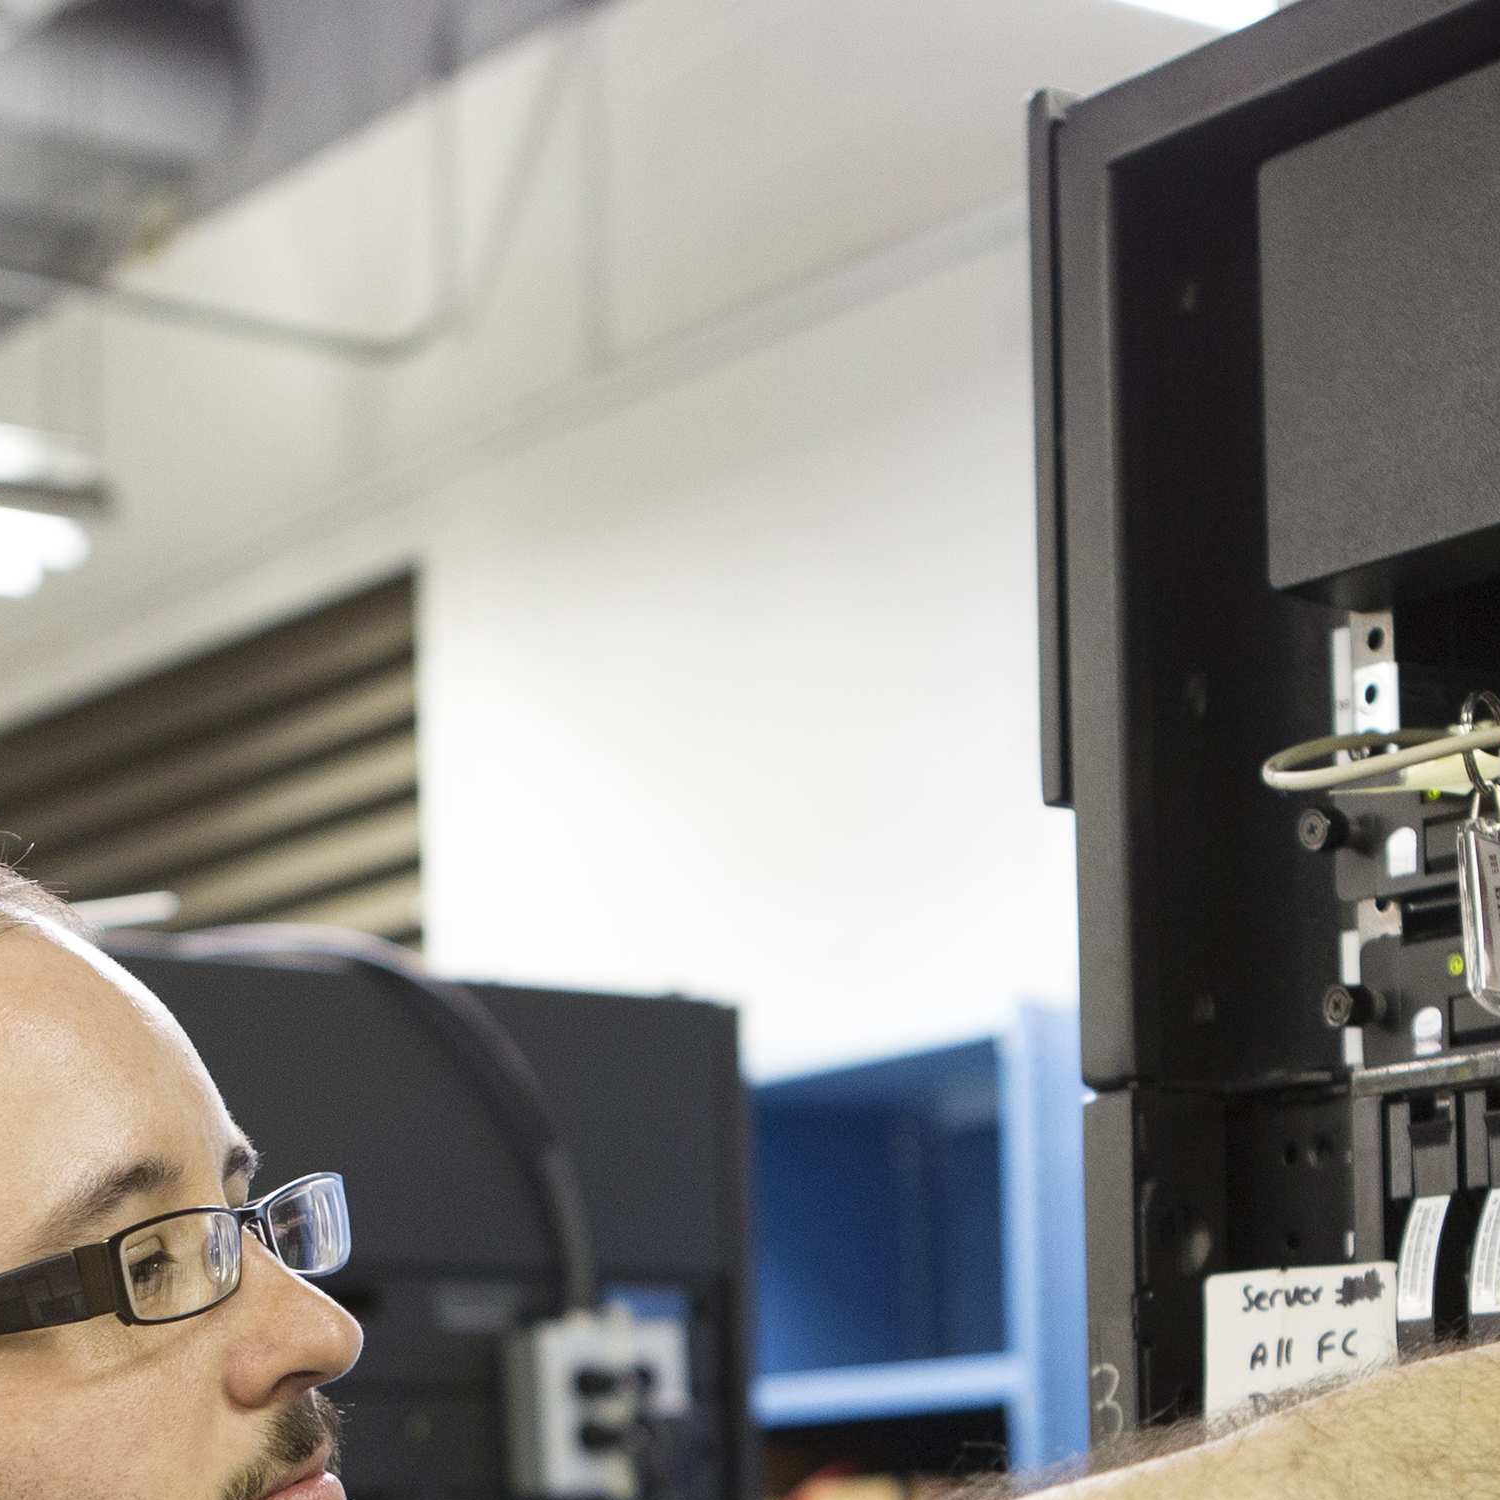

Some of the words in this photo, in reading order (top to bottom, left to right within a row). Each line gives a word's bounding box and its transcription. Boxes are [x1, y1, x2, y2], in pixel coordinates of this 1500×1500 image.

[1241, 1284, 1324, 1313] Server
[1250, 1336, 1294, 1371] All
[1316, 1327, 1358, 1364] FC
